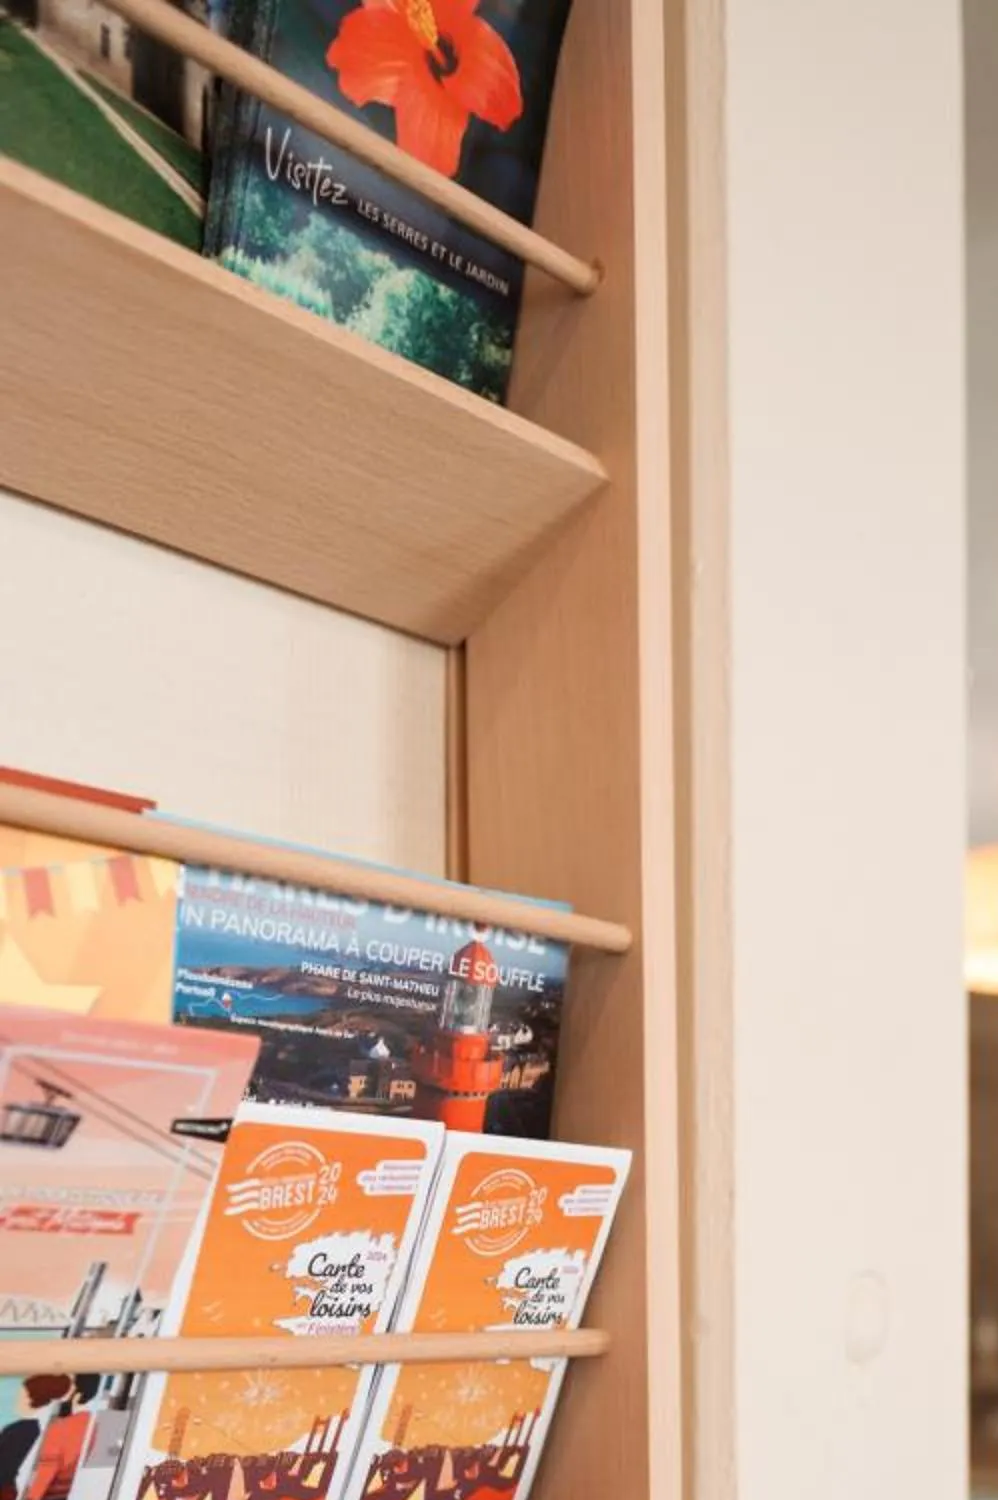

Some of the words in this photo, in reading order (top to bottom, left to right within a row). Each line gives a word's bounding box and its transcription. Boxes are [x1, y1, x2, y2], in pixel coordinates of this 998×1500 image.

[265, 126, 348, 206] Visitez
[357, 198, 379, 222] LES
[383, 213, 428, 251] SERRES
[431, 239, 447, 261] ET
[449, 251, 463, 271] LE
[465, 262, 509, 296] JARDIN
[210, 909, 340, 952] PANORAMA
[346, 930, 360, 957] À
[366, 940, 444, 974] COUPER
[448, 956, 472, 978] LE
[474, 960, 545, 992] SOUFFLE
[301, 961, 340, 981] PHARE
[342, 969, 358, 983] DE
[319, 1161, 342, 1184] 20
[259, 1181, 316, 1209] BREST
[479, 1203, 526, 1229] BREST
[308, 1252, 365, 1278] Carte
[515, 1267, 560, 1289] Carte
[330, 1275, 347, 1294] de
[351, 1282, 373, 1295] vos
[310, 1289, 371, 1318] loisirs
[513, 1300, 562, 1325] loisirs
